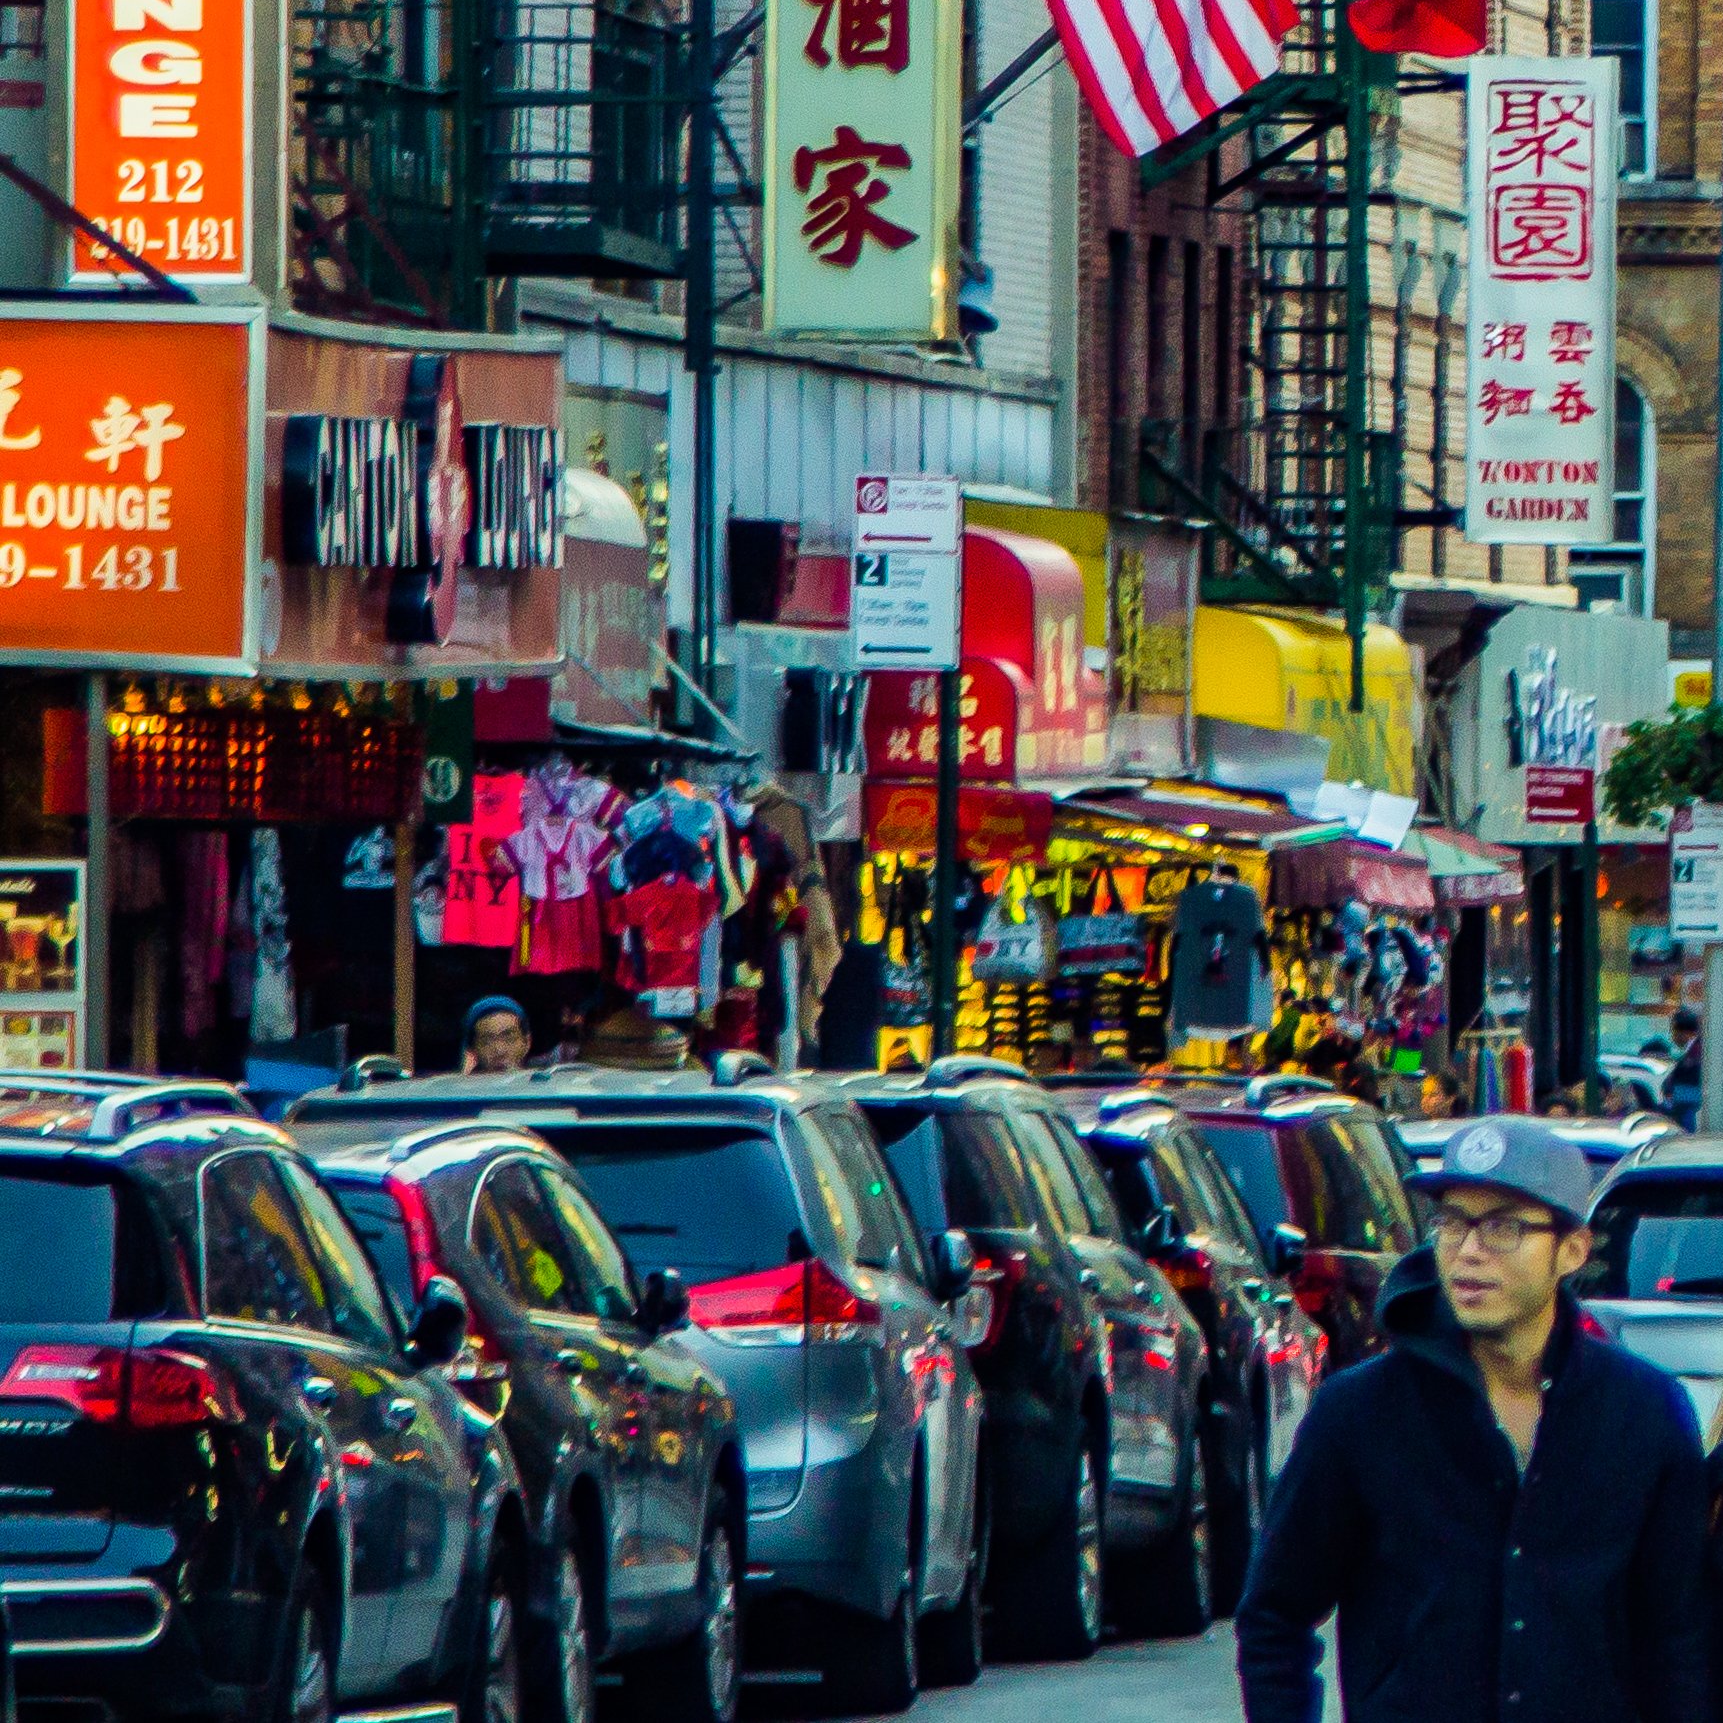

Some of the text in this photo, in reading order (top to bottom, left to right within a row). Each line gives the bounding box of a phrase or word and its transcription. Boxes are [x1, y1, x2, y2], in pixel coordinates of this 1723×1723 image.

[118, 160, 204, 203] 212
[2, 484, 172, 531] LOUNGE
[1484, 496, 1589, 522] GARDEN
